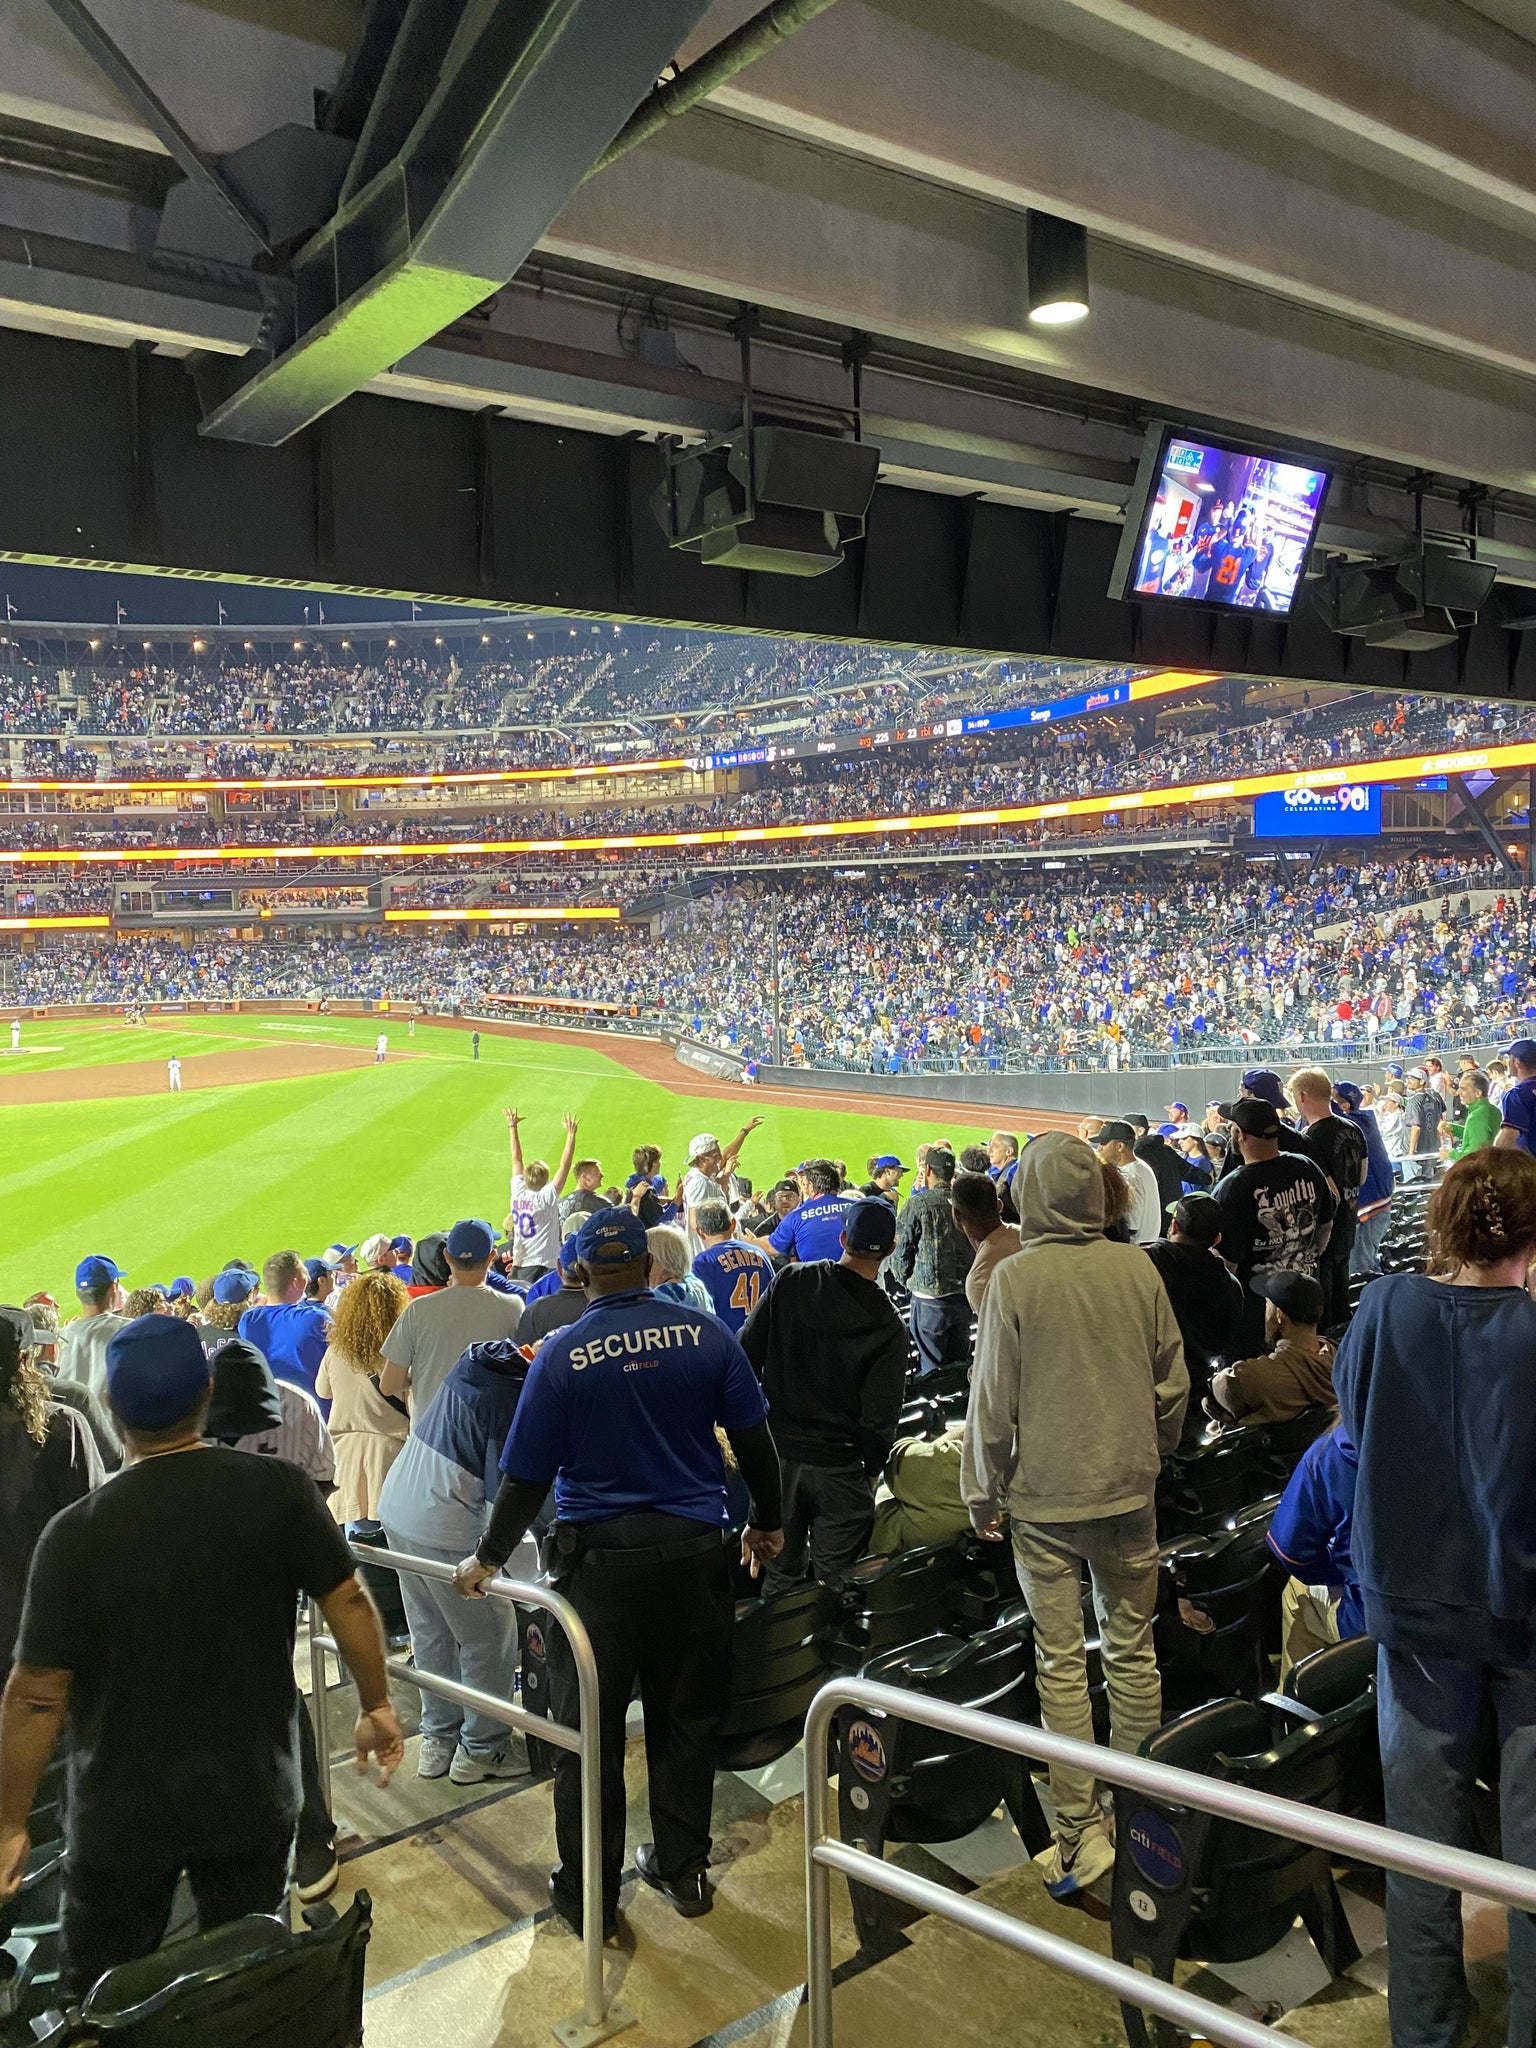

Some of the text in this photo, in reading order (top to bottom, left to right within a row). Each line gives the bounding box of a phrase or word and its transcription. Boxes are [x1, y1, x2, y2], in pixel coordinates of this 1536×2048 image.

[1217, 555, 1241, 584] 21
[1086, 689, 1119, 711] pitches 8
[858, 724, 944, 747] avg .225 hr 23 rbi 60
[1338, 787, 1365, 811] 90
[1253, 1178, 1317, 1210] Loyalty
[729, 1271, 760, 1316] 41
[569, 1324, 701, 1371] SECURITY
[623, 1360, 659, 1373] citi FIELD
[1130, 1828, 1151, 1849] citi
[1138, 1899, 1148, 1912] 13
